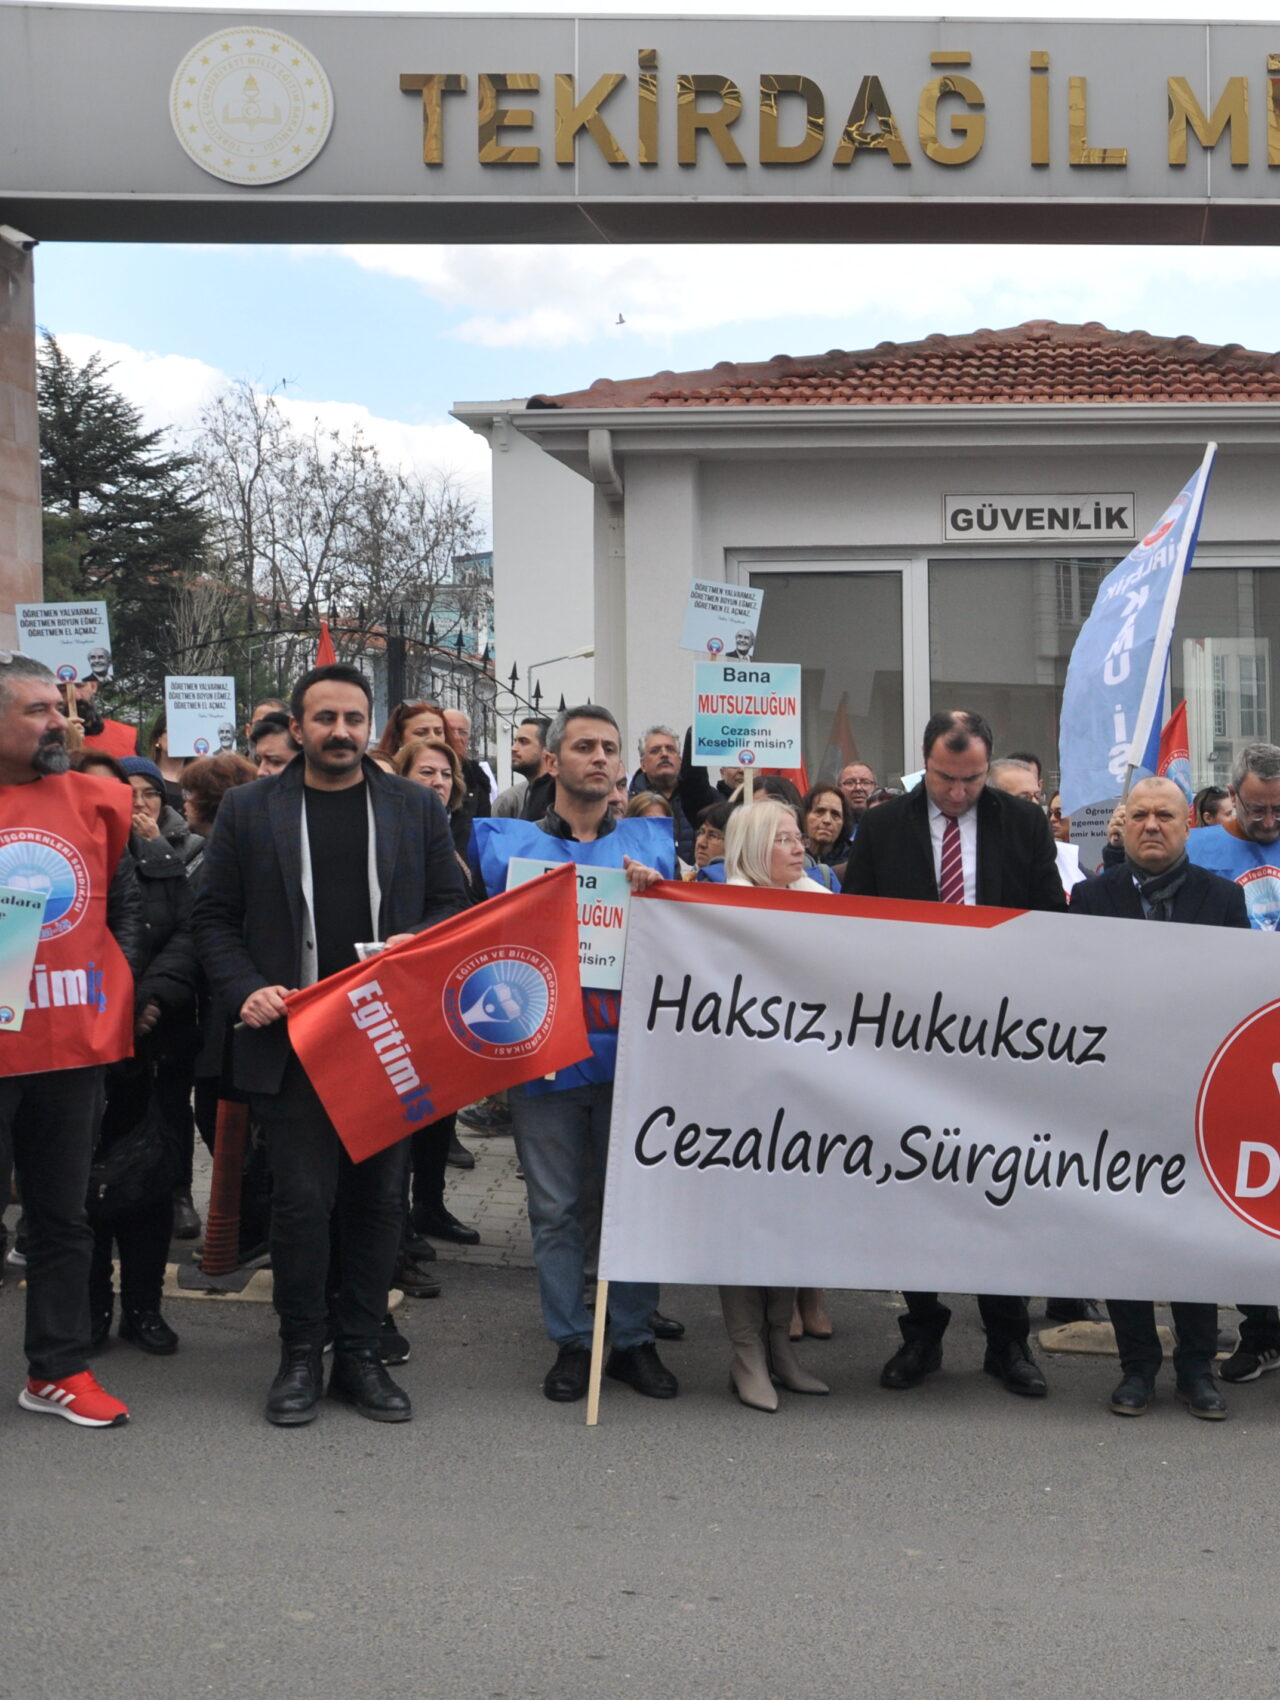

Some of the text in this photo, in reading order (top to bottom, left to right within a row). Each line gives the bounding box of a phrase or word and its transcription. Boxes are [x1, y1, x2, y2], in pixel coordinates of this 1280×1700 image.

[400, 49, 985, 167] TEKİRDAĞ
[1030, 51, 1128, 168] İL
[950, 502, 1128, 532] GÜVENLİK
[723, 667, 771, 684] Bana
[698, 691, 797, 717] MUTSUZLUĞUN
[721, 726, 772, 737] Cezasını
[697, 737, 794, 749] Kesebilir misin?
